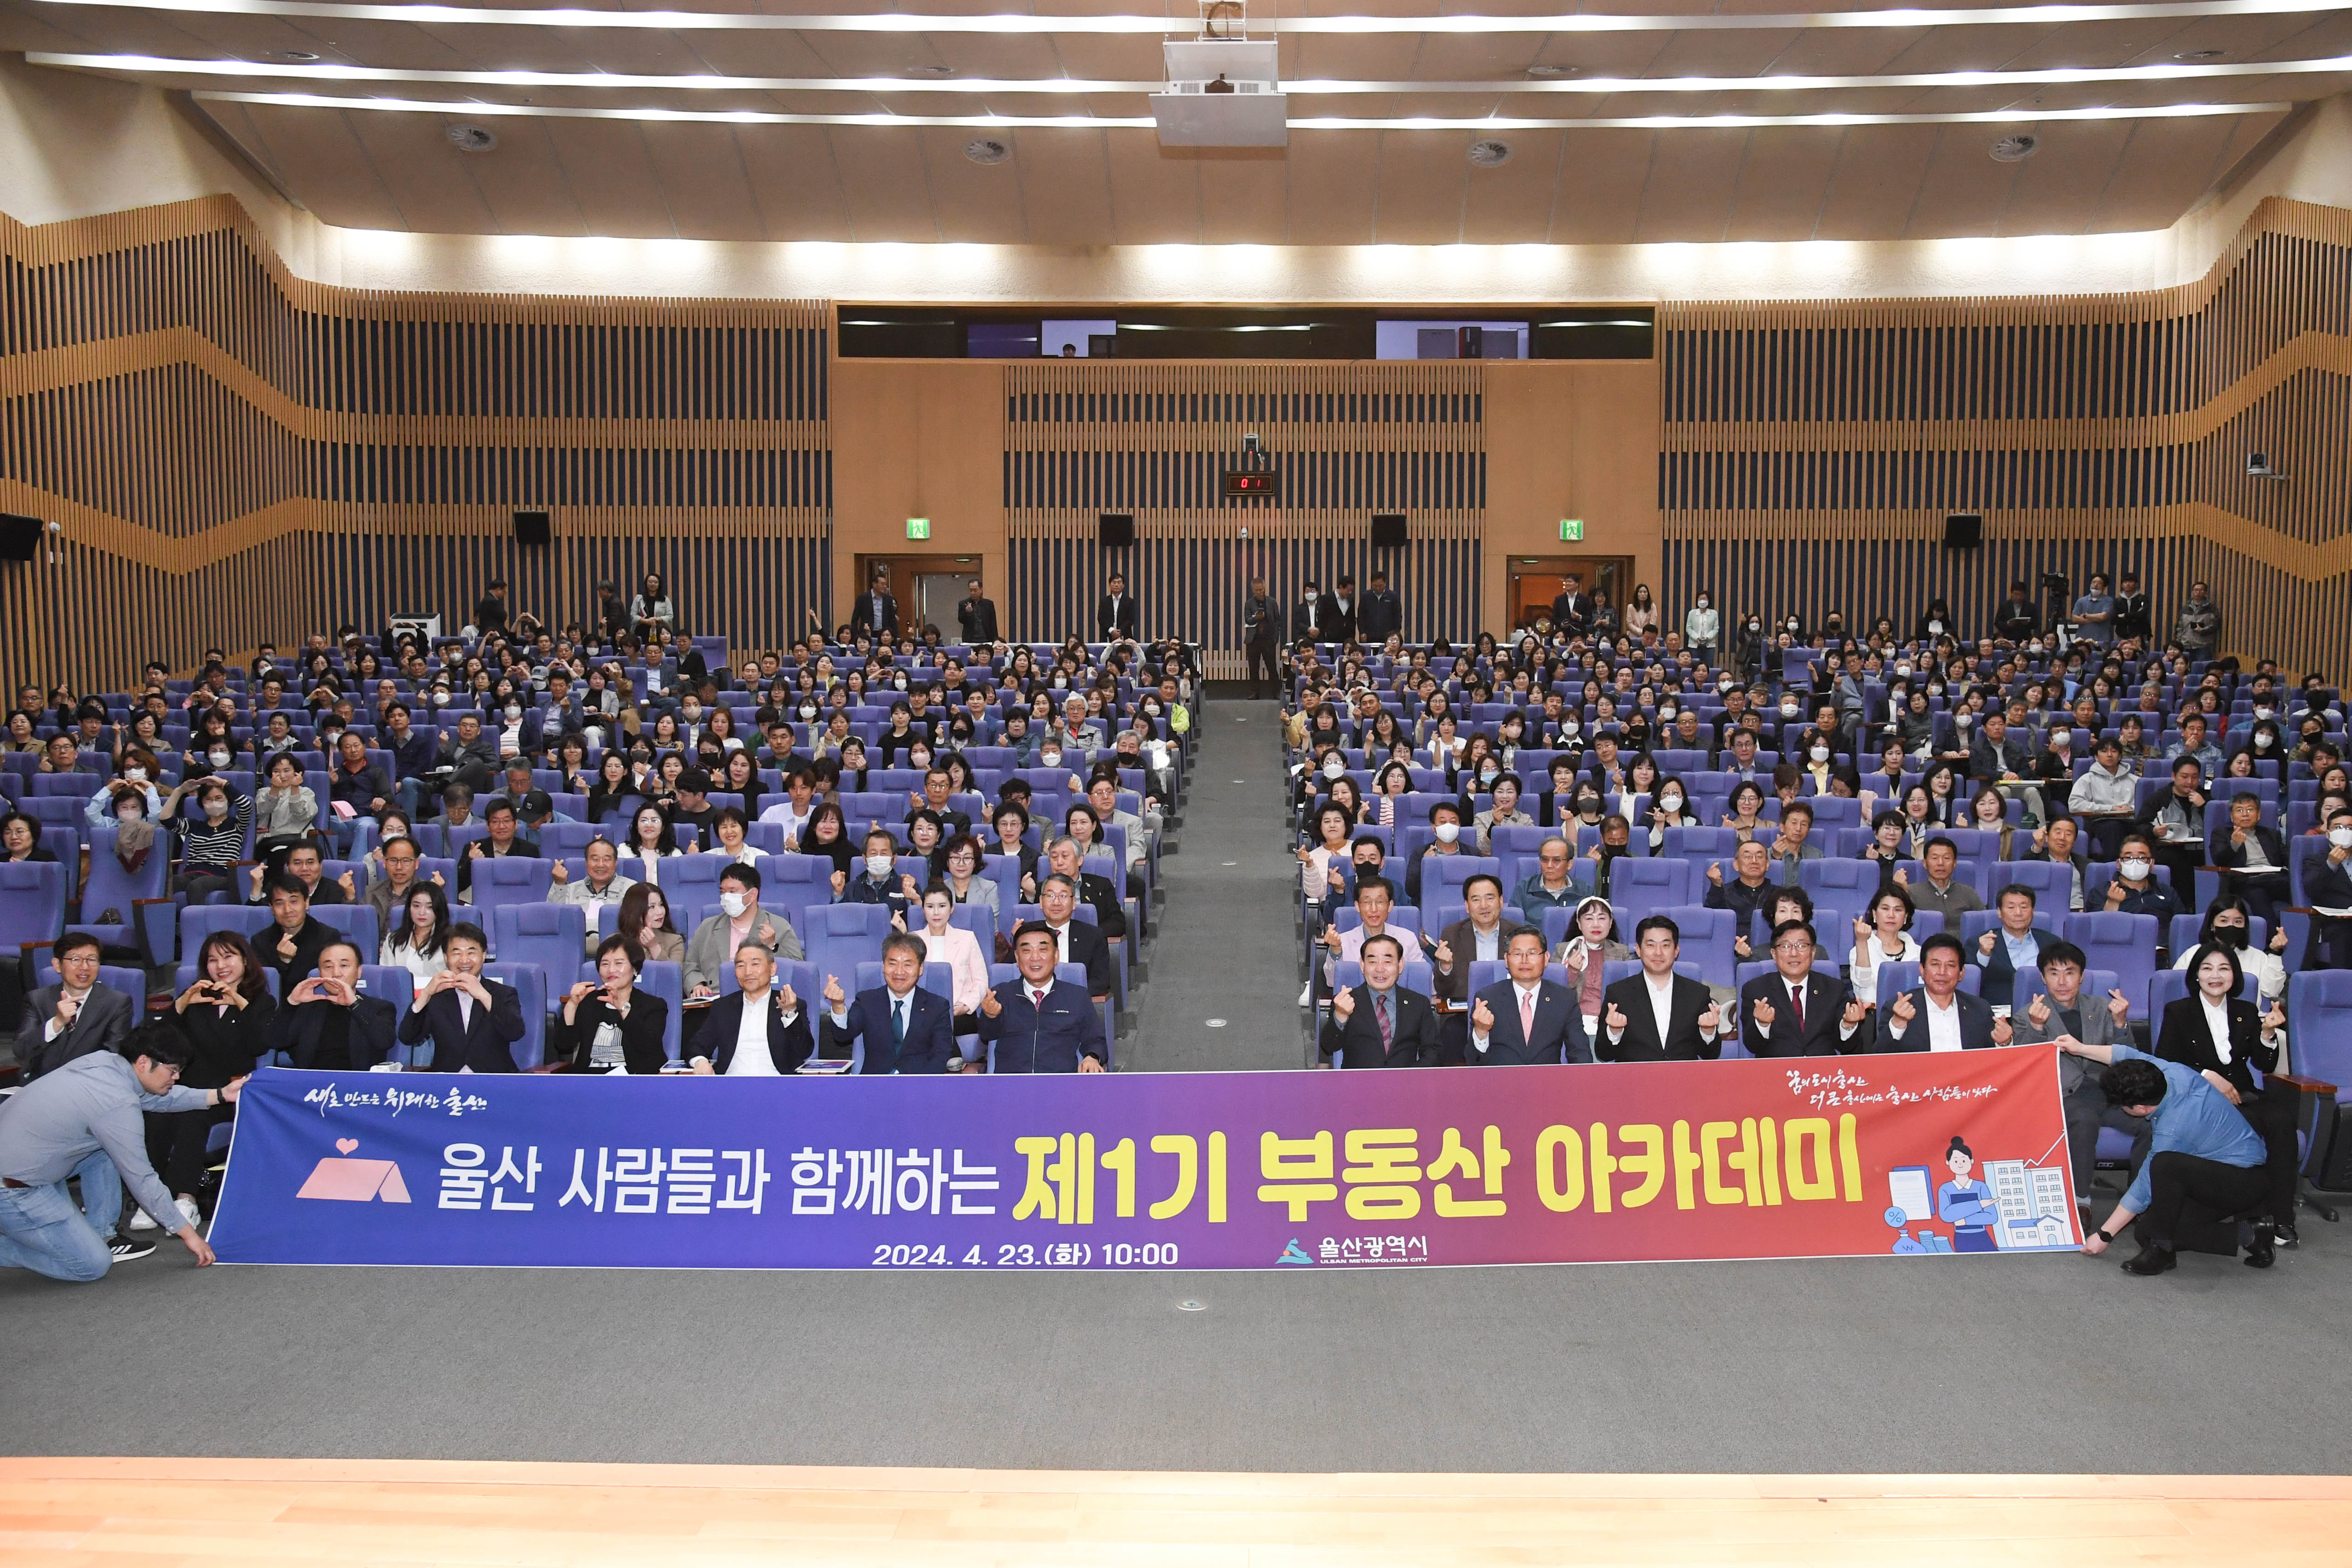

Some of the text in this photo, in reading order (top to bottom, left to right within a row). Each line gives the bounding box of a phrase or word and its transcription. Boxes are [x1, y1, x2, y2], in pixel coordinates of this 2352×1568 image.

[1786, 1068, 1869, 1095] 꿈의 도시 울산
[304, 1082, 488, 1118] 새로 만드는 위대한 울산
[1809, 1090, 1826, 1110] 더
[1826, 1090, 1842, 1106] 큰
[1842, 1089, 1884, 1106] 울산에는
[1885, 1085, 1923, 1105] 울산
[1922, 1086, 1970, 1102] 사람들이
[438, 1112, 1863, 1225] 울산 사람들과 함께하는 제1기 부동산 아카데미
[871, 1242, 1179, 1265] 2024. 4. 23.(화) 10:00
[1318, 1235, 1428, 1258] 울산광역시
